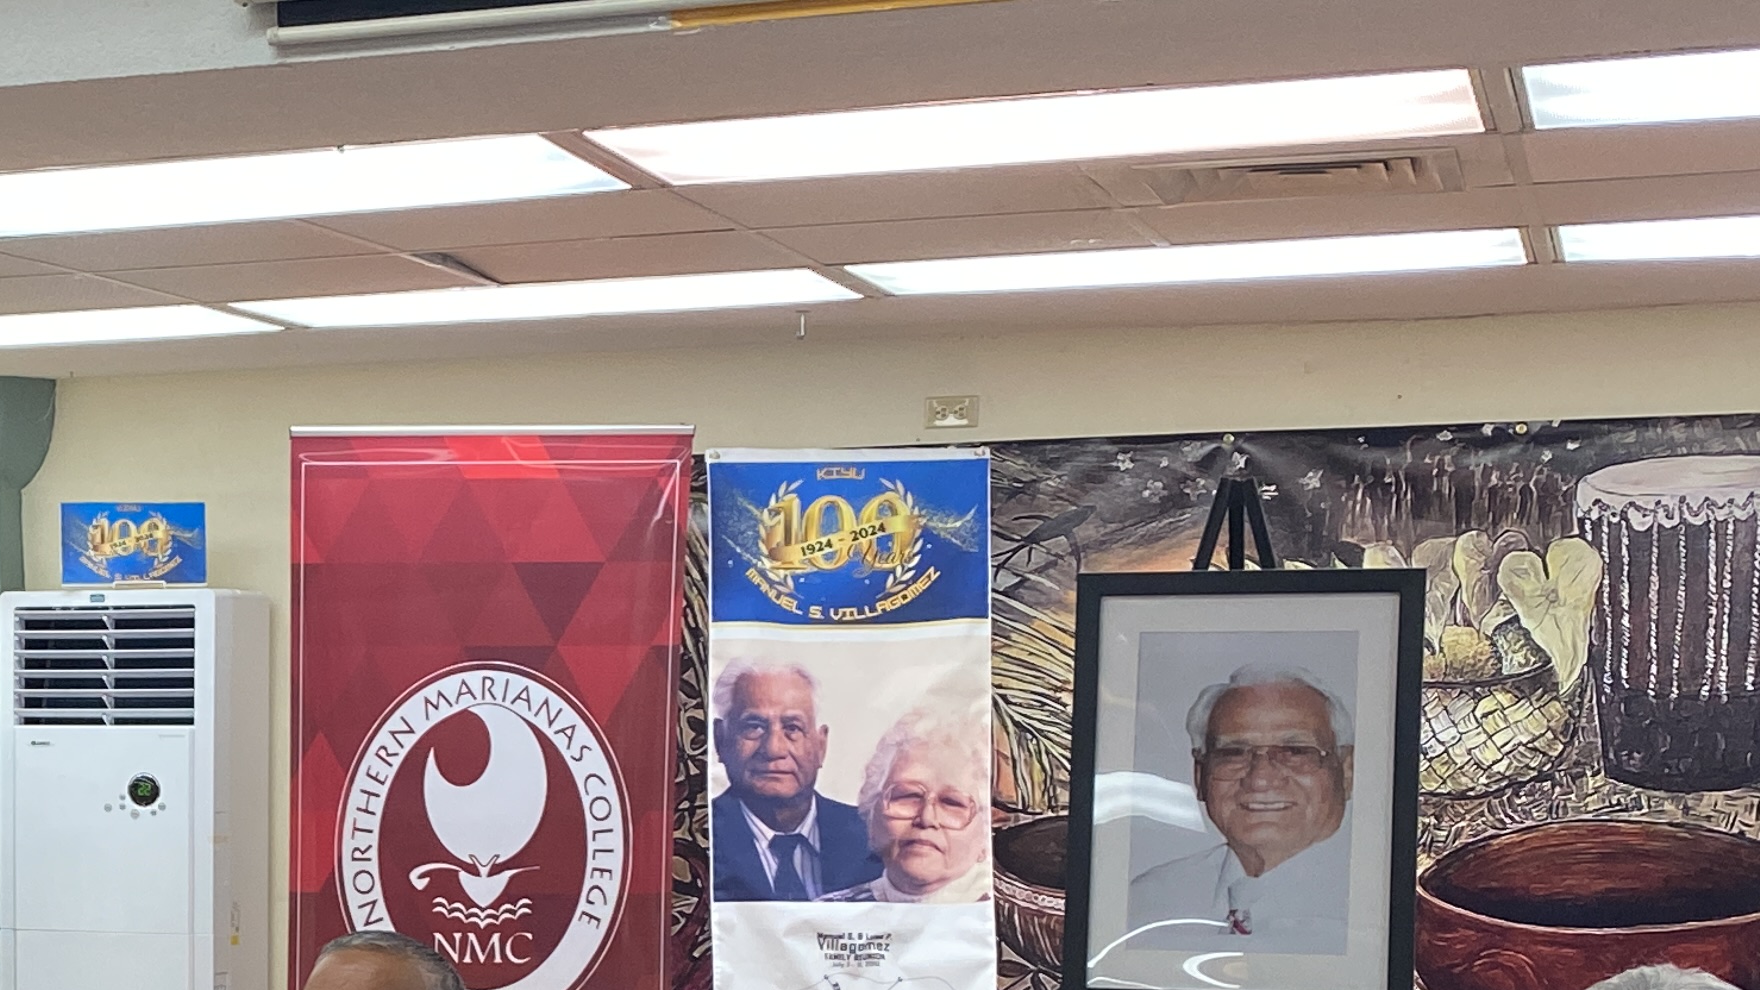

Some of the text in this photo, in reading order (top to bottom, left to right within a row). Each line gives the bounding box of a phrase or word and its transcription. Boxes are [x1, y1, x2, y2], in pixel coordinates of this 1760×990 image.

[816, 466, 866, 481] KIYU
[766, 492, 919, 571] 100
[800, 538, 833, 557] 1924
[850, 522, 886, 542] 2024
[745, 567, 803, 615] MANUEL
[829, 566, 941, 621] VILLAGOMEZ
[423, 676, 592, 763] MARIANAS
[351, 717, 416, 928] NORTHERN
[578, 773, 615, 930] COLLEGE
[433, 932, 534, 964] NMC
[817, 937, 890, 954] Villagomez
